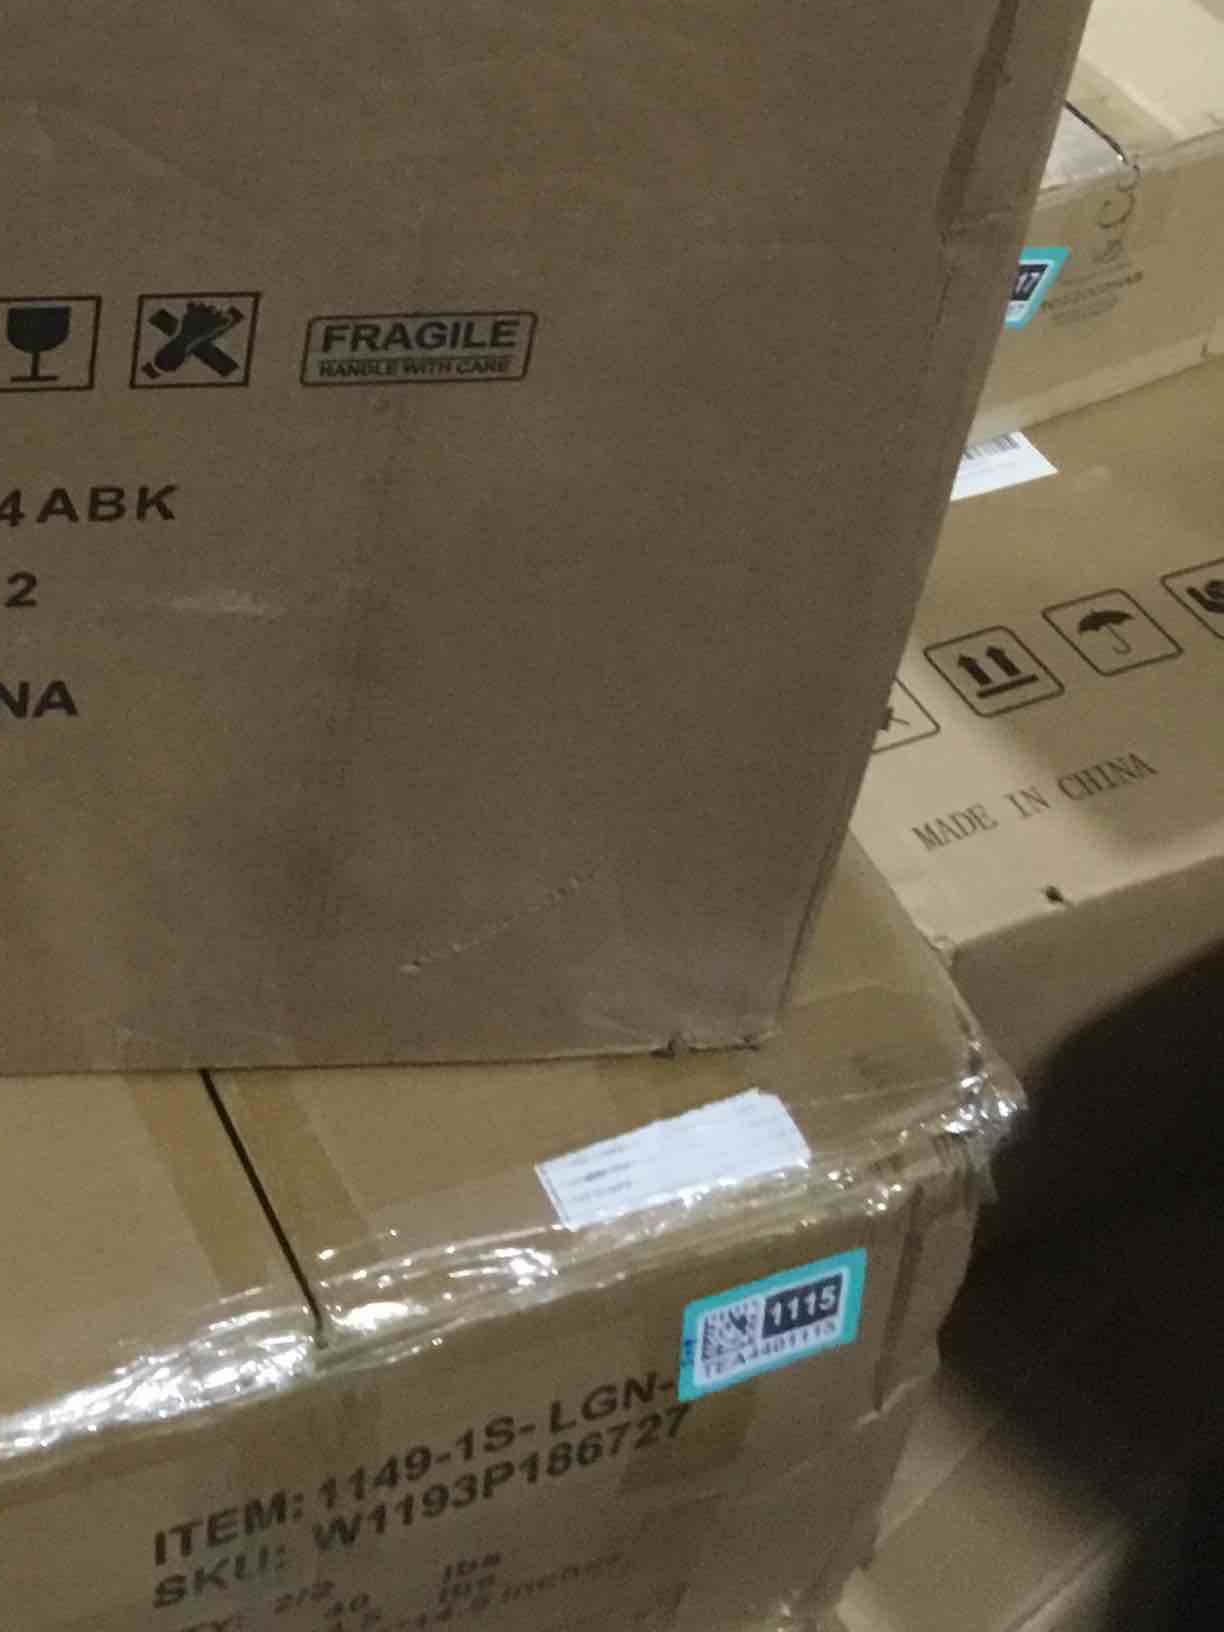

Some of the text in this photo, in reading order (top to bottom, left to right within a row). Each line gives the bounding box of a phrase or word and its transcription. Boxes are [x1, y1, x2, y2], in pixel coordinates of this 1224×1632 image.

[322, 319, 521, 353] FRAGILE
[402, 356, 452, 375] WITH
[5, 571, 39, 609] 2
[911, 751, 1159, 852] MADE IN CHINA
[770, 1284, 837, 1328] 1115
[152, 1401, 692, 1609] SKU: W1193P186727
[154, 1490, 305, 1567] ITEM:
